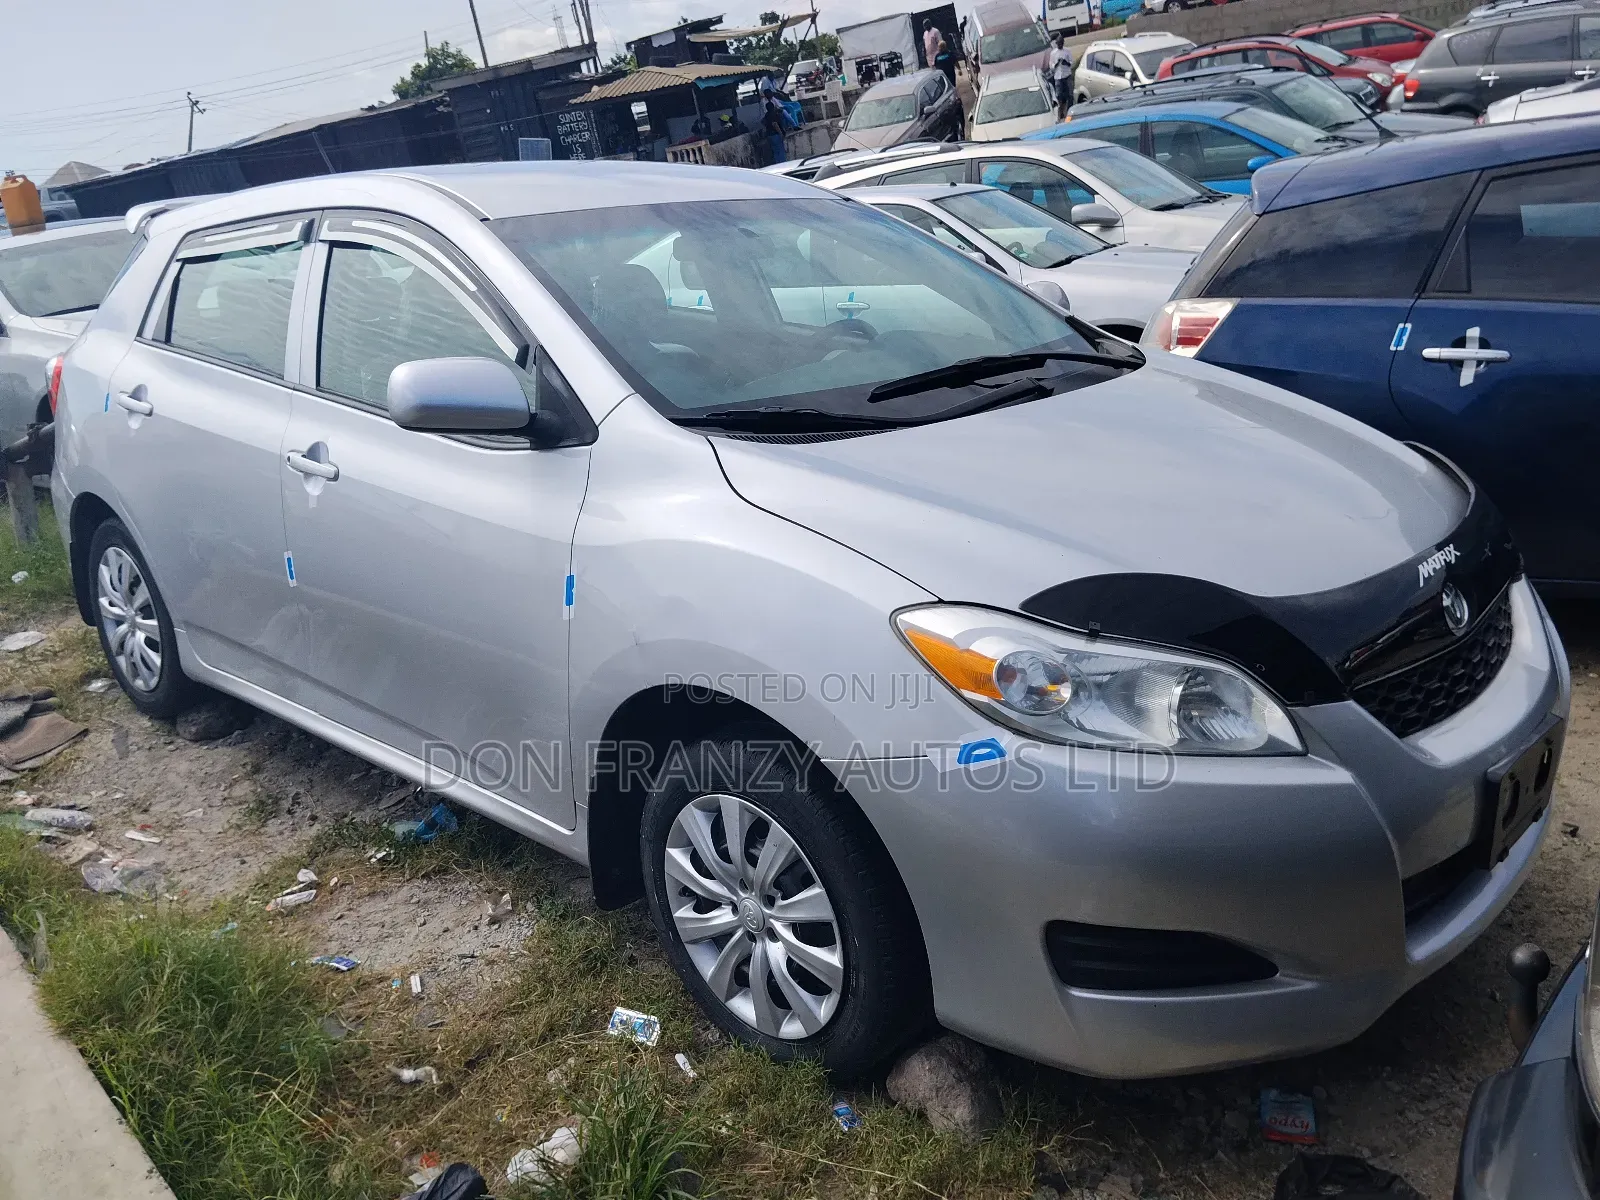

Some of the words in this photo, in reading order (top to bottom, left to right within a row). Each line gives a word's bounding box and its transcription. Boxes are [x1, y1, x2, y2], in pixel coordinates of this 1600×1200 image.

[559, 111, 586, 124] SUNTEX
[557, 121, 589, 134] BATTERY
[560, 132, 591, 146] CHARGER
[572, 144, 582, 153] IS
[1417, 543, 1461, 587] MATRIX
